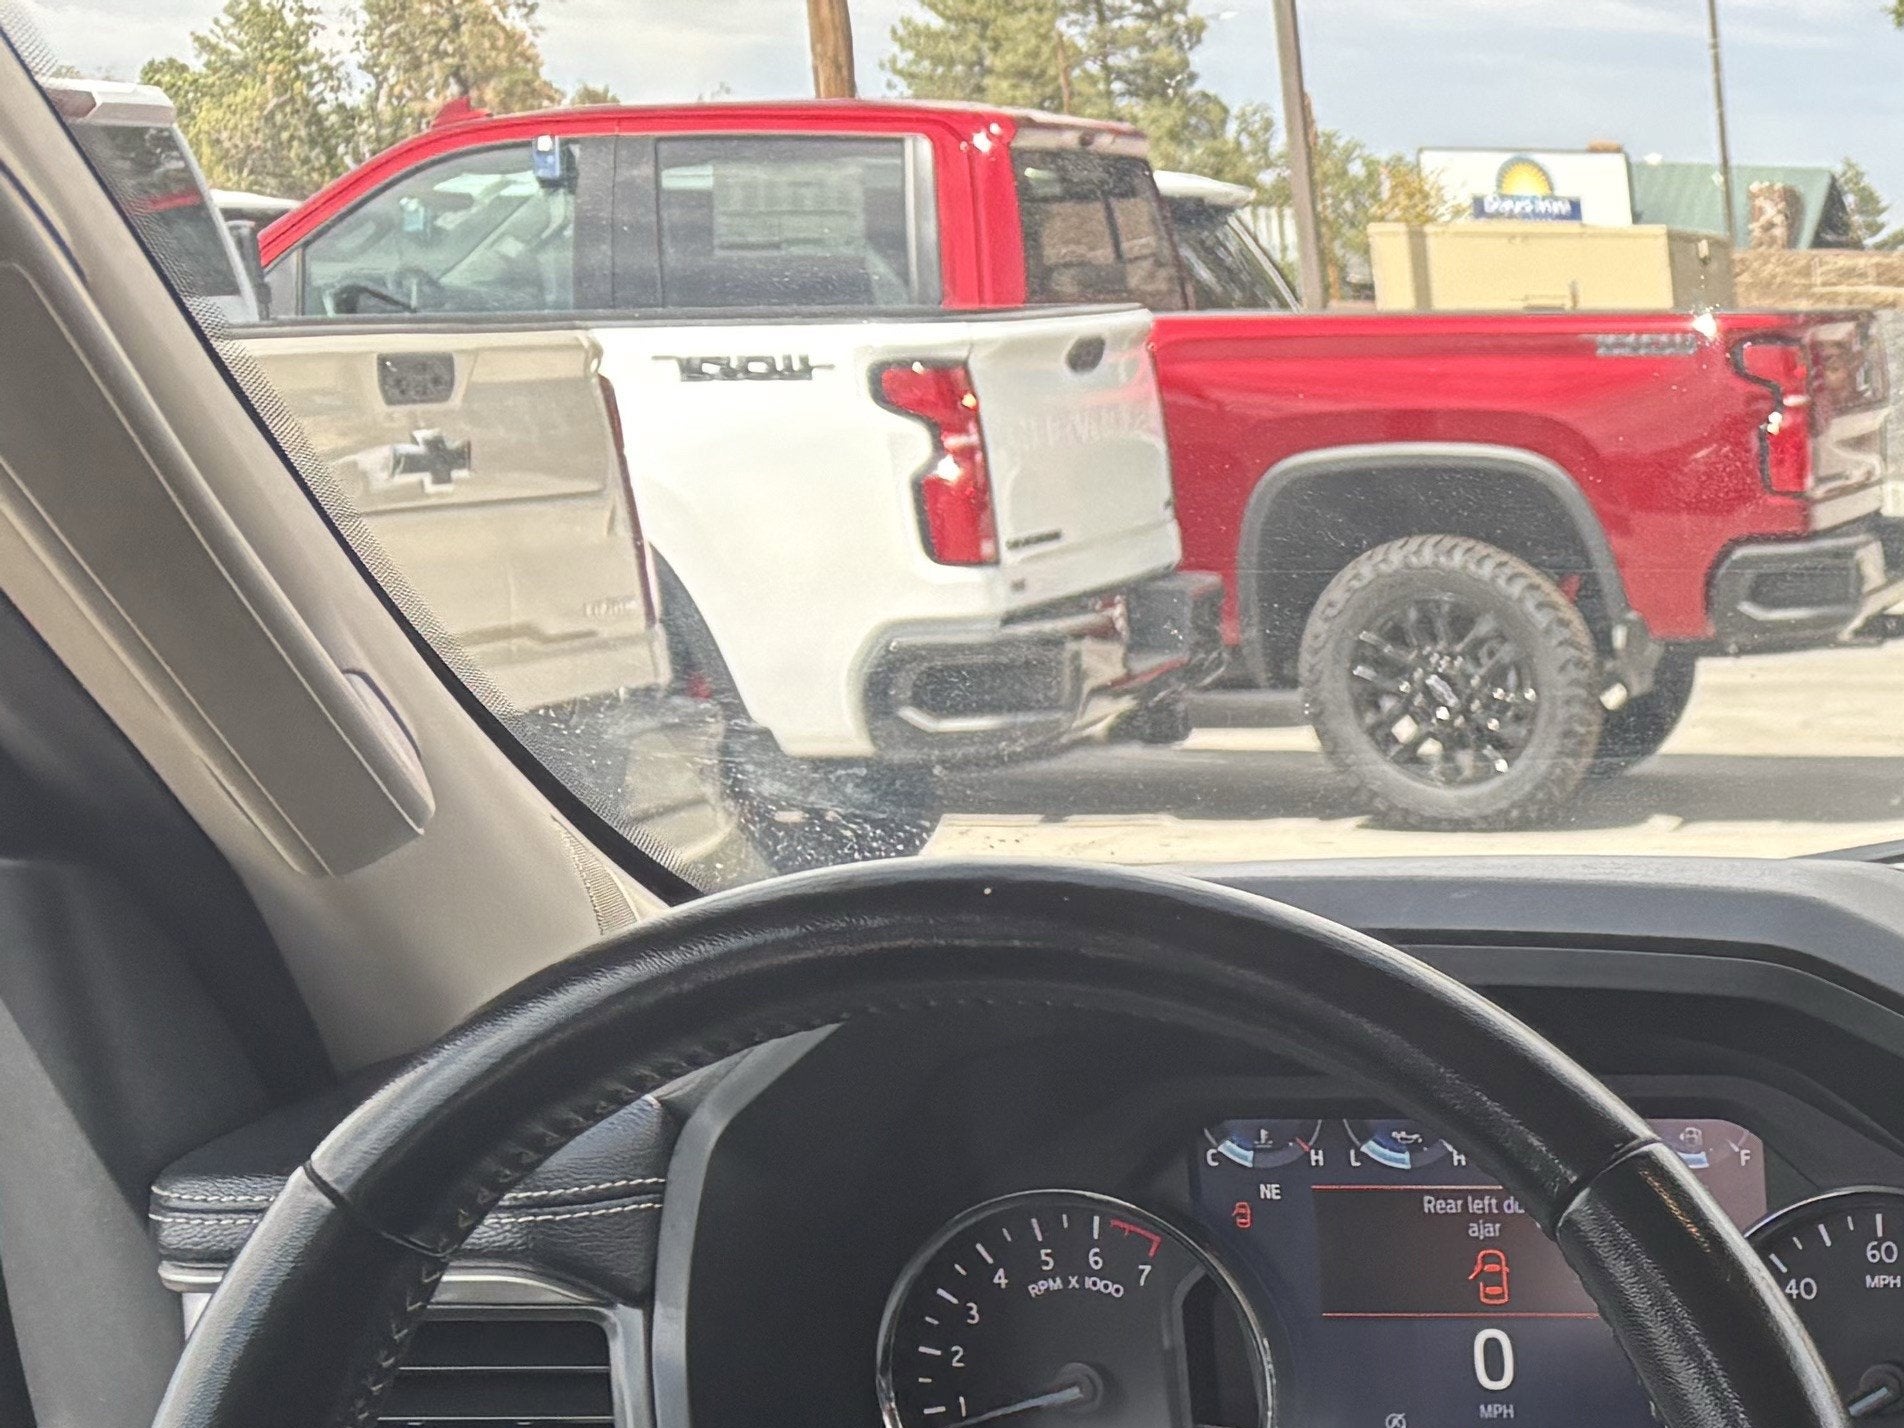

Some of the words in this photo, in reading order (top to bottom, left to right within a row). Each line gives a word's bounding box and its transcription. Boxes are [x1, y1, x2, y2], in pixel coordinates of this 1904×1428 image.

[1206, 1149, 1219, 1167] C
[1310, 1149, 1325, 1167] H
[1350, 1149, 1361, 1167] L
[1740, 1149, 1751, 1167] F
[1259, 1183, 1282, 1200] NE
[1423, 1195, 1463, 1213] Rear
[1467, 1195, 1499, 1213] left
[1468, 1219, 1501, 1240] ajar
[1040, 1248, 1054, 1271] 5
[1088, 1247, 1103, 1271] 6
[1866, 1241, 1898, 1264] 60
[993, 1267, 1009, 1289] 4
[1138, 1264, 1152, 1286] 7
[1865, 1275, 1902, 1289] MPH
[1028, 1278, 1064, 1298] RPM
[1068, 1275, 1080, 1289] X
[1085, 1276, 1125, 1298] 1000
[1785, 1278, 1818, 1300] 40
[966, 1302, 980, 1325] 3
[951, 1345, 965, 1368] 2
[1473, 1328, 1515, 1391] 0
[959, 1396, 967, 1418] 1
[1479, 1404, 1515, 1419] MPH
